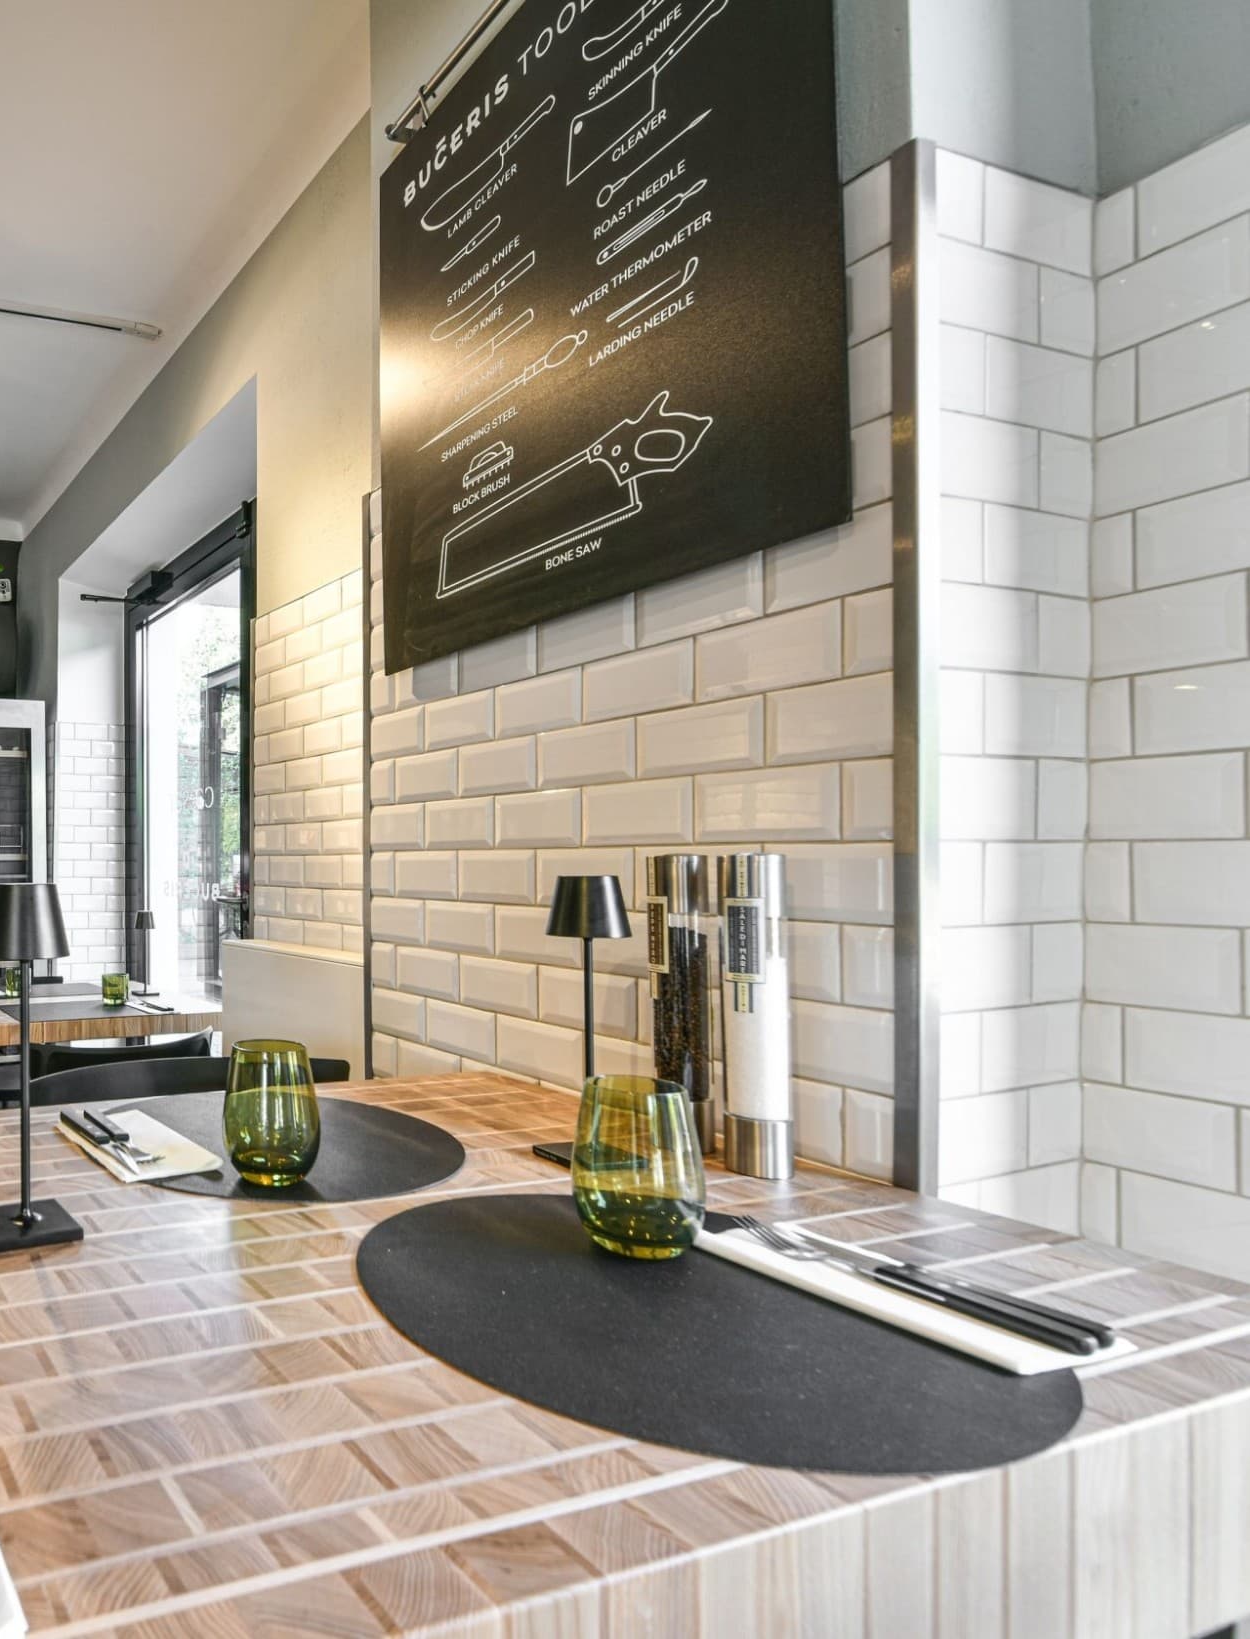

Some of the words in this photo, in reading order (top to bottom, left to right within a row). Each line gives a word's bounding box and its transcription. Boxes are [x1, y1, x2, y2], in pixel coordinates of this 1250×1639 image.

[589, 42, 643, 100] SKINNING
[646, 3, 681, 46] KNIFE
[404, 74, 508, 207] BUČERIS
[612, 109, 666, 161] CLEAVER
[448, 209, 471, 238] LAMB
[475, 164, 516, 210] CLEAVER
[594, 202, 631, 239] ROAST
[637, 159, 685, 206] NEEDLE
[447, 264, 488, 306] STICKING
[493, 235, 519, 266] KNIFE
[570, 283, 608, 316] WATER
[611, 211, 711, 287] THERMOMETER
[455, 323, 480, 352] CHOP
[480, 303, 503, 330] KNIFE
[590, 326, 641, 366] LARDING
[644, 292, 694, 332] NEEDLE
[441, 428, 489, 462] SHARPENING
[492, 407, 518, 428] STEEL
[453, 492, 480, 513] BLOCK
[482, 474, 510, 497] BRUSH
[546, 549, 574, 570] BONE
[576, 538, 601, 557] SAW
